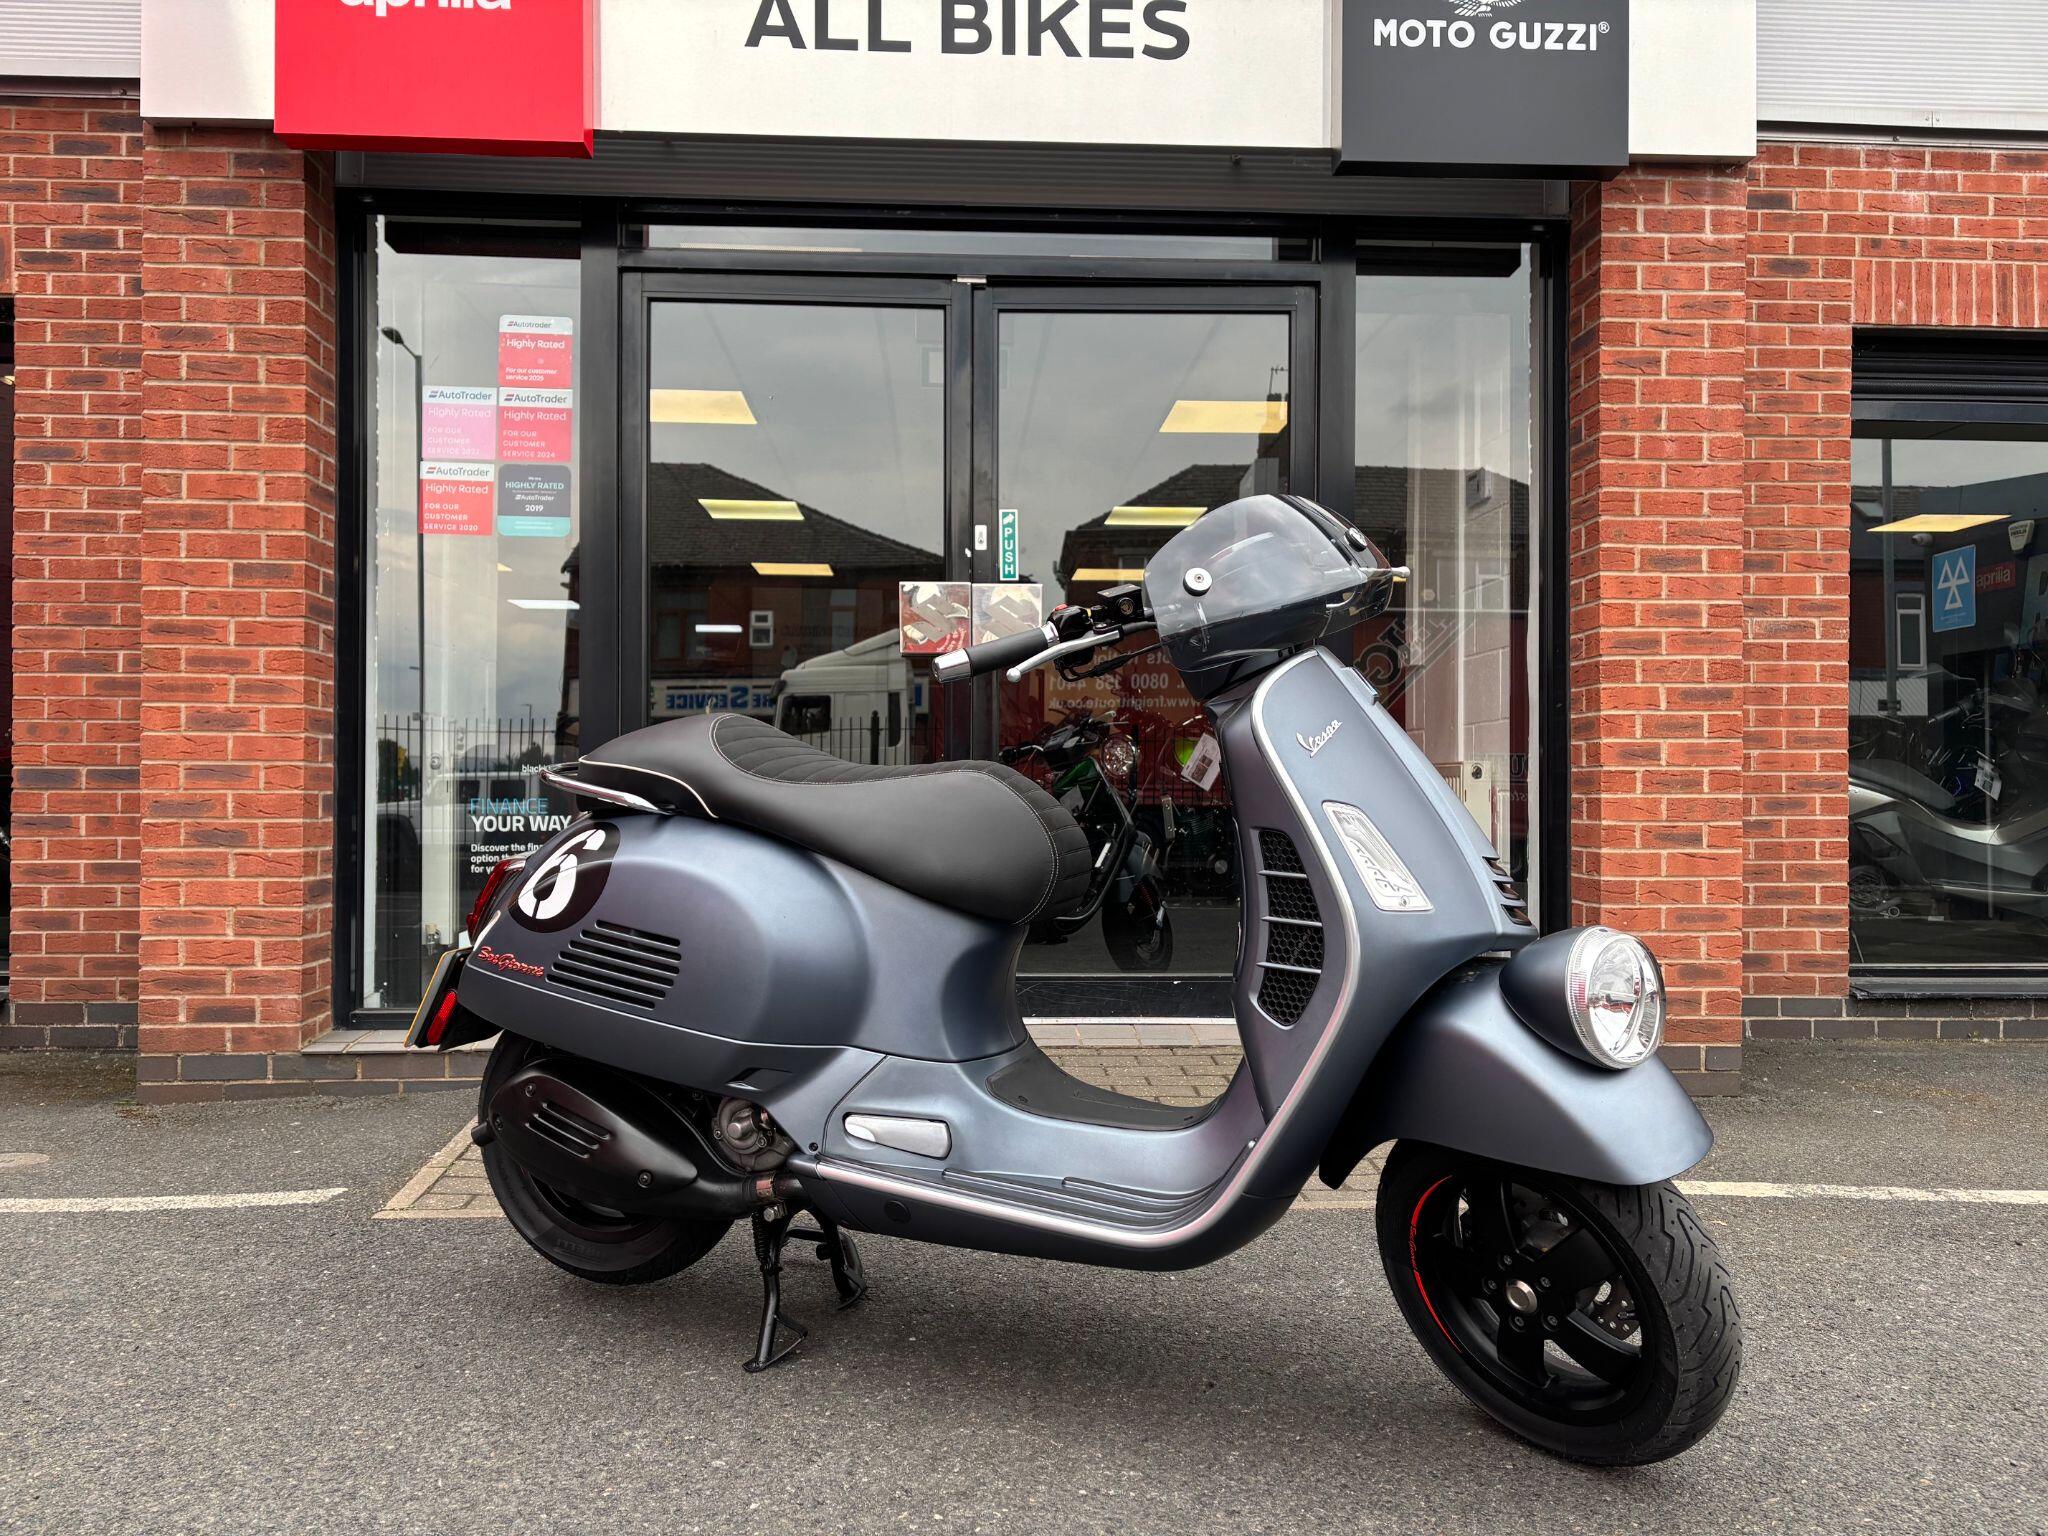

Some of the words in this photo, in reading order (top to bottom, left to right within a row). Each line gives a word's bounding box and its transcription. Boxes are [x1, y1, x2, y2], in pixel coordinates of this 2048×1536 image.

[745, 0, 912, 53] ALL
[941, 0, 1190, 60] BIKES
[1374, 19, 1475, 48] MOTO
[506, 338, 536, 349] Highly
[537, 339, 565, 349] Rated
[438, 390, 492, 400] AutoTrader
[514, 393, 568, 404] AutoTrader
[428, 407, 459, 419] Highly
[503, 410, 535, 422] Highly
[537, 411, 567, 421] Rated
[503, 429, 519, 437] FOR
[520, 430, 537, 438] OUR
[503, 439, 545, 448] CUSTOMER
[503, 449, 536, 458] SERVICE
[436, 466, 490, 477] AutoTrader
[425, 483, 458, 495] Highly
[458, 484, 488, 495] Rated
[505, 481, 536, 490] HIGHLY
[537, 482, 564, 490] RATED
[424, 502, 441, 510] FOR
[525, 504, 544, 512] 2019
[424, 512, 468, 521] CUSTOMER
[424, 522, 457, 531] SERVICE
[1004, 527, 1014, 575] PUSH
[470, 797, 549, 814] FINANCE
[470, 815, 525, 832] YOUR
[529, 815, 572, 832] WAY
[470, 843, 509, 853] Discover
[510, 843, 526, 852] the
[470, 853, 500, 864] option
[470, 864, 484, 874] for
